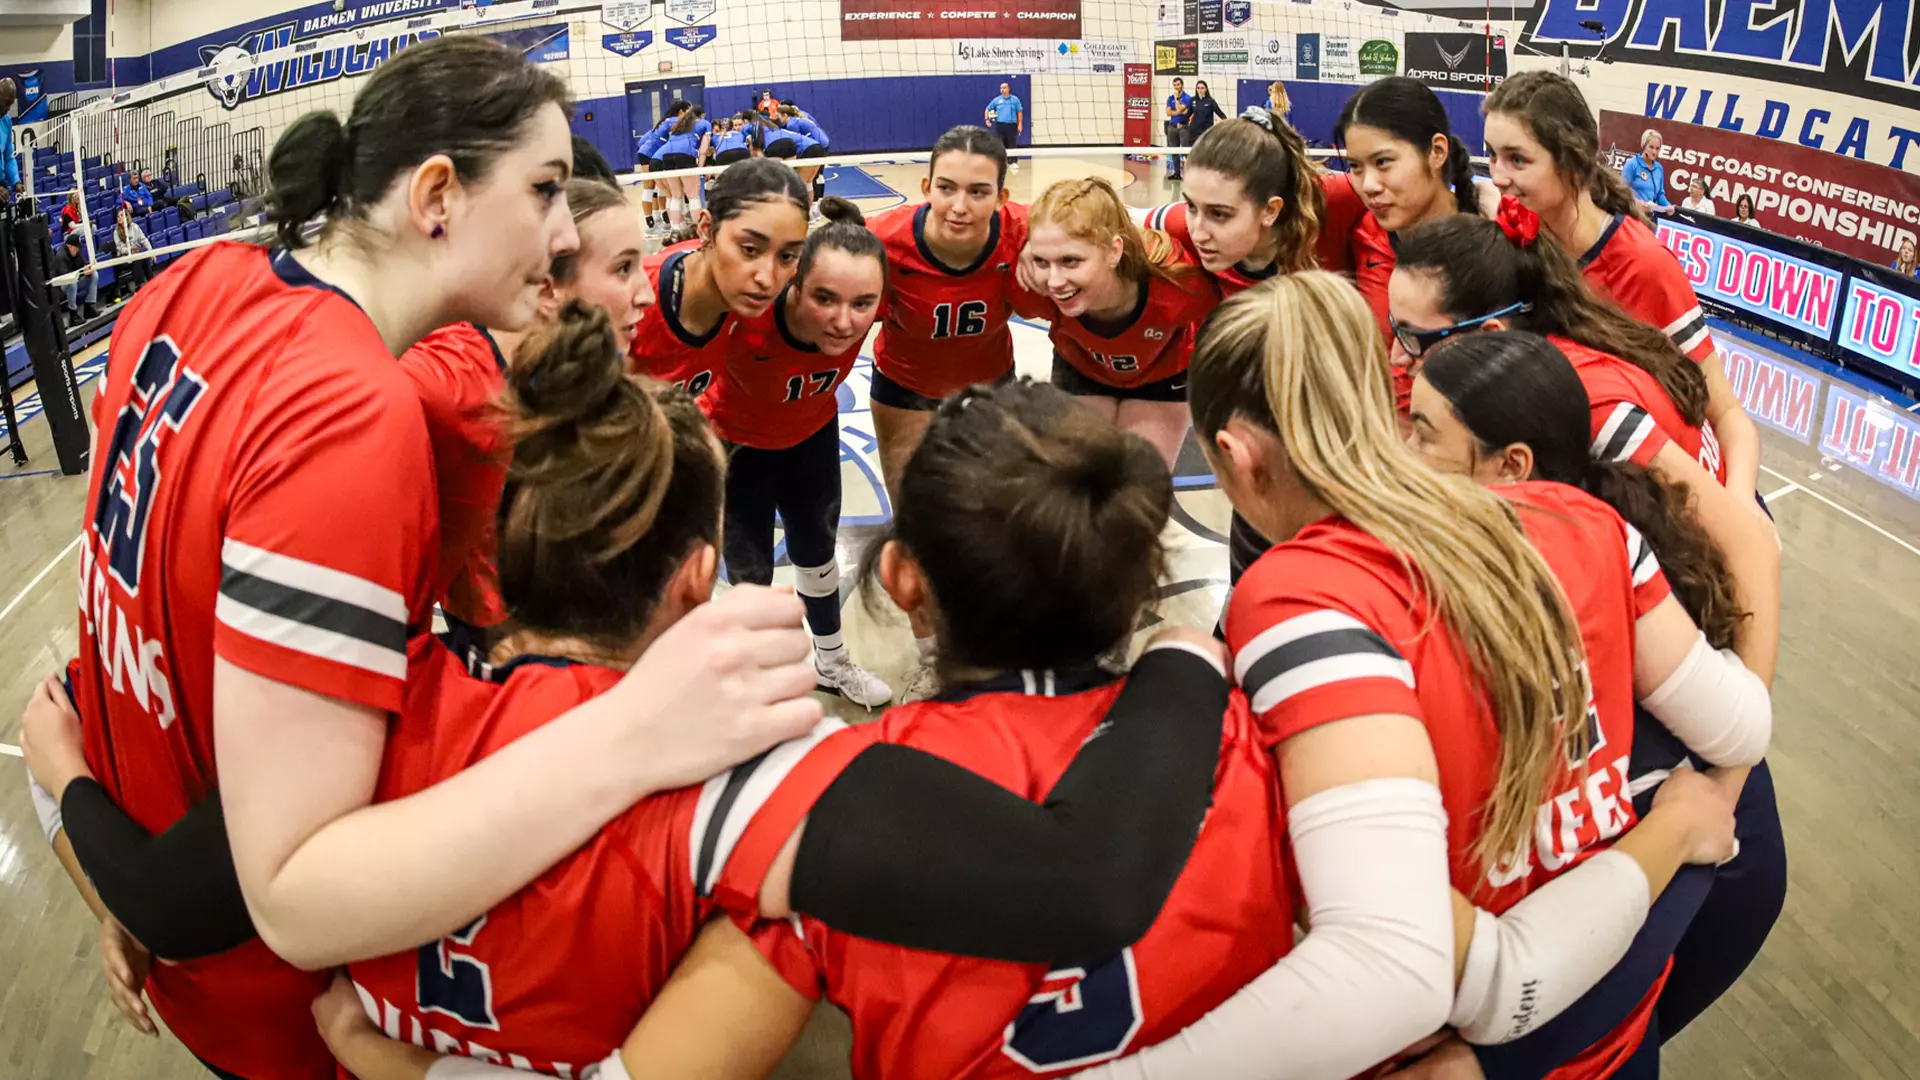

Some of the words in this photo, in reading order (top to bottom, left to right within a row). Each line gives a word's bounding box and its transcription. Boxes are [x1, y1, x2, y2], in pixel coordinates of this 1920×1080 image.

[303, 10, 357, 33] DAEMEN
[845, 11, 921, 21] EXPERIENCE
[940, 11, 996, 19] COMPETE
[1017, 11, 1077, 20] CHAMPION
[971, 47, 991, 58] Lake
[992, 46, 1014, 58] Shore
[1016, 47, 1045, 61] Savings
[1083, 42, 1128, 51] COLLEGIATE
[1326, 41, 1347, 49] Daemen
[1326, 49, 1348, 57] Wildcats
[1407, 69, 1447, 80] ADPRO
[1450, 72, 1504, 84] SPORTS
[1658, 145, 1708, 174] EAST
[1711, 156, 1782, 191] COAST
[1783, 172, 1920, 226] CONFERENC
[1715, 242, 1837, 332] DOWN
[931, 300, 987, 340] 16
[1850, 285, 1902, 356] TO
[61, 359, 72, 387] sports
[68, 386, 80, 420] imports
[782, 368, 841, 404] 17
